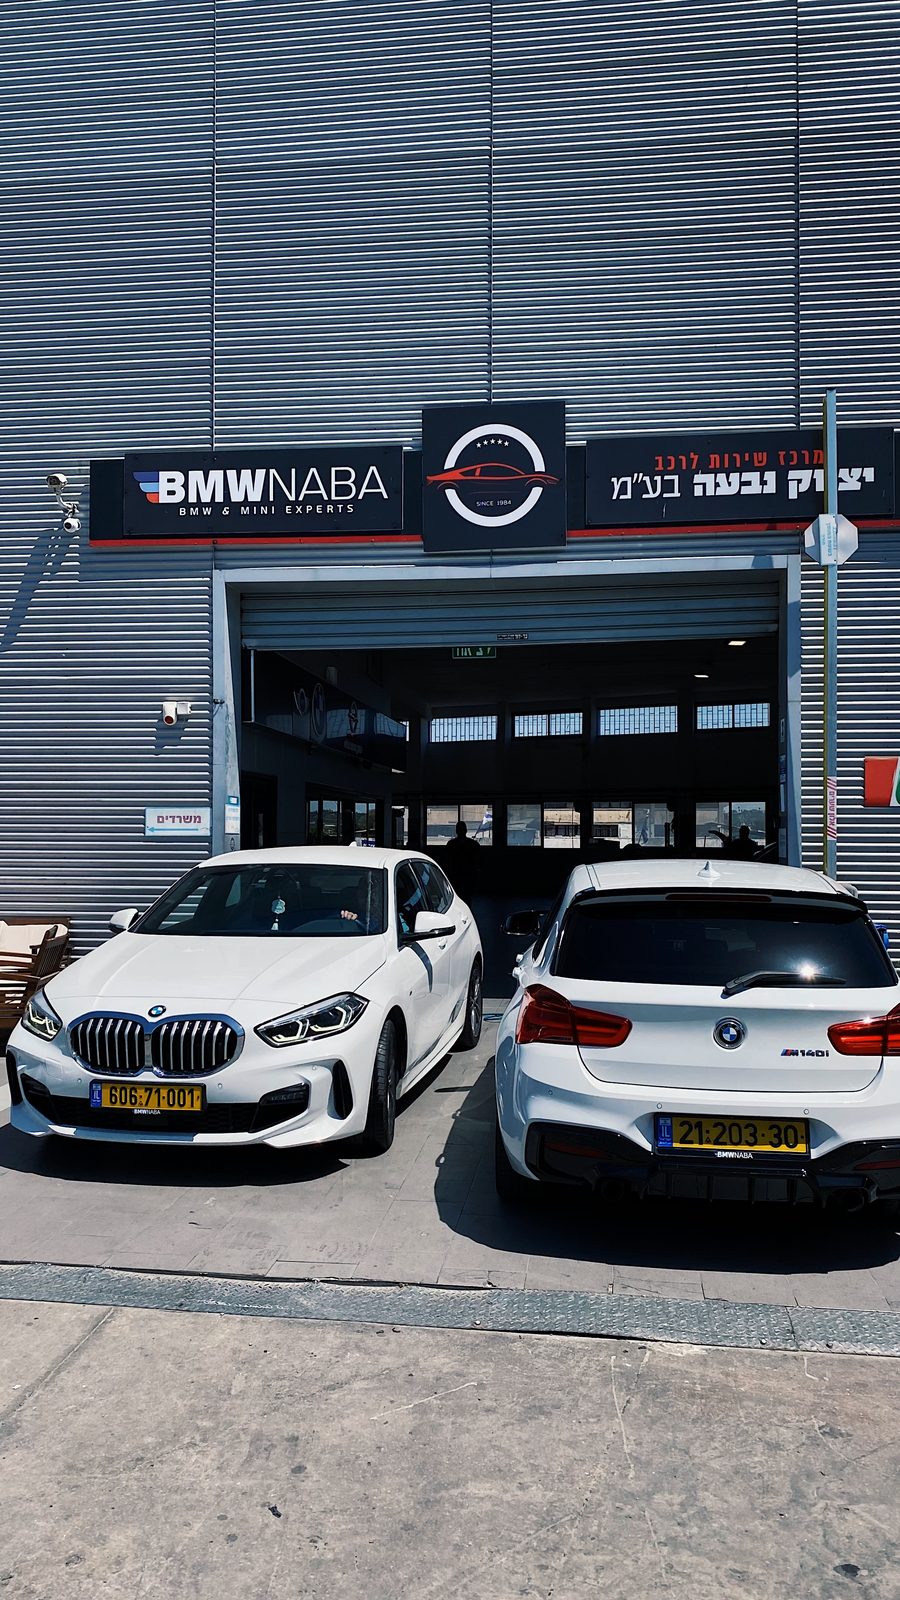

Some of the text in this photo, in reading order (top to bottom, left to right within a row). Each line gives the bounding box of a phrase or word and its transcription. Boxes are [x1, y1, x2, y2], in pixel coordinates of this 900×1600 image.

[654, 449, 824, 471] מרכז שירות לרכב
[693, 470, 776, 496] נבעה
[179, 503, 355, 516] BMW & MINI EXPERTS
[156, 815, 202, 824] משרדים
[661, 1125, 671, 1138] IL
